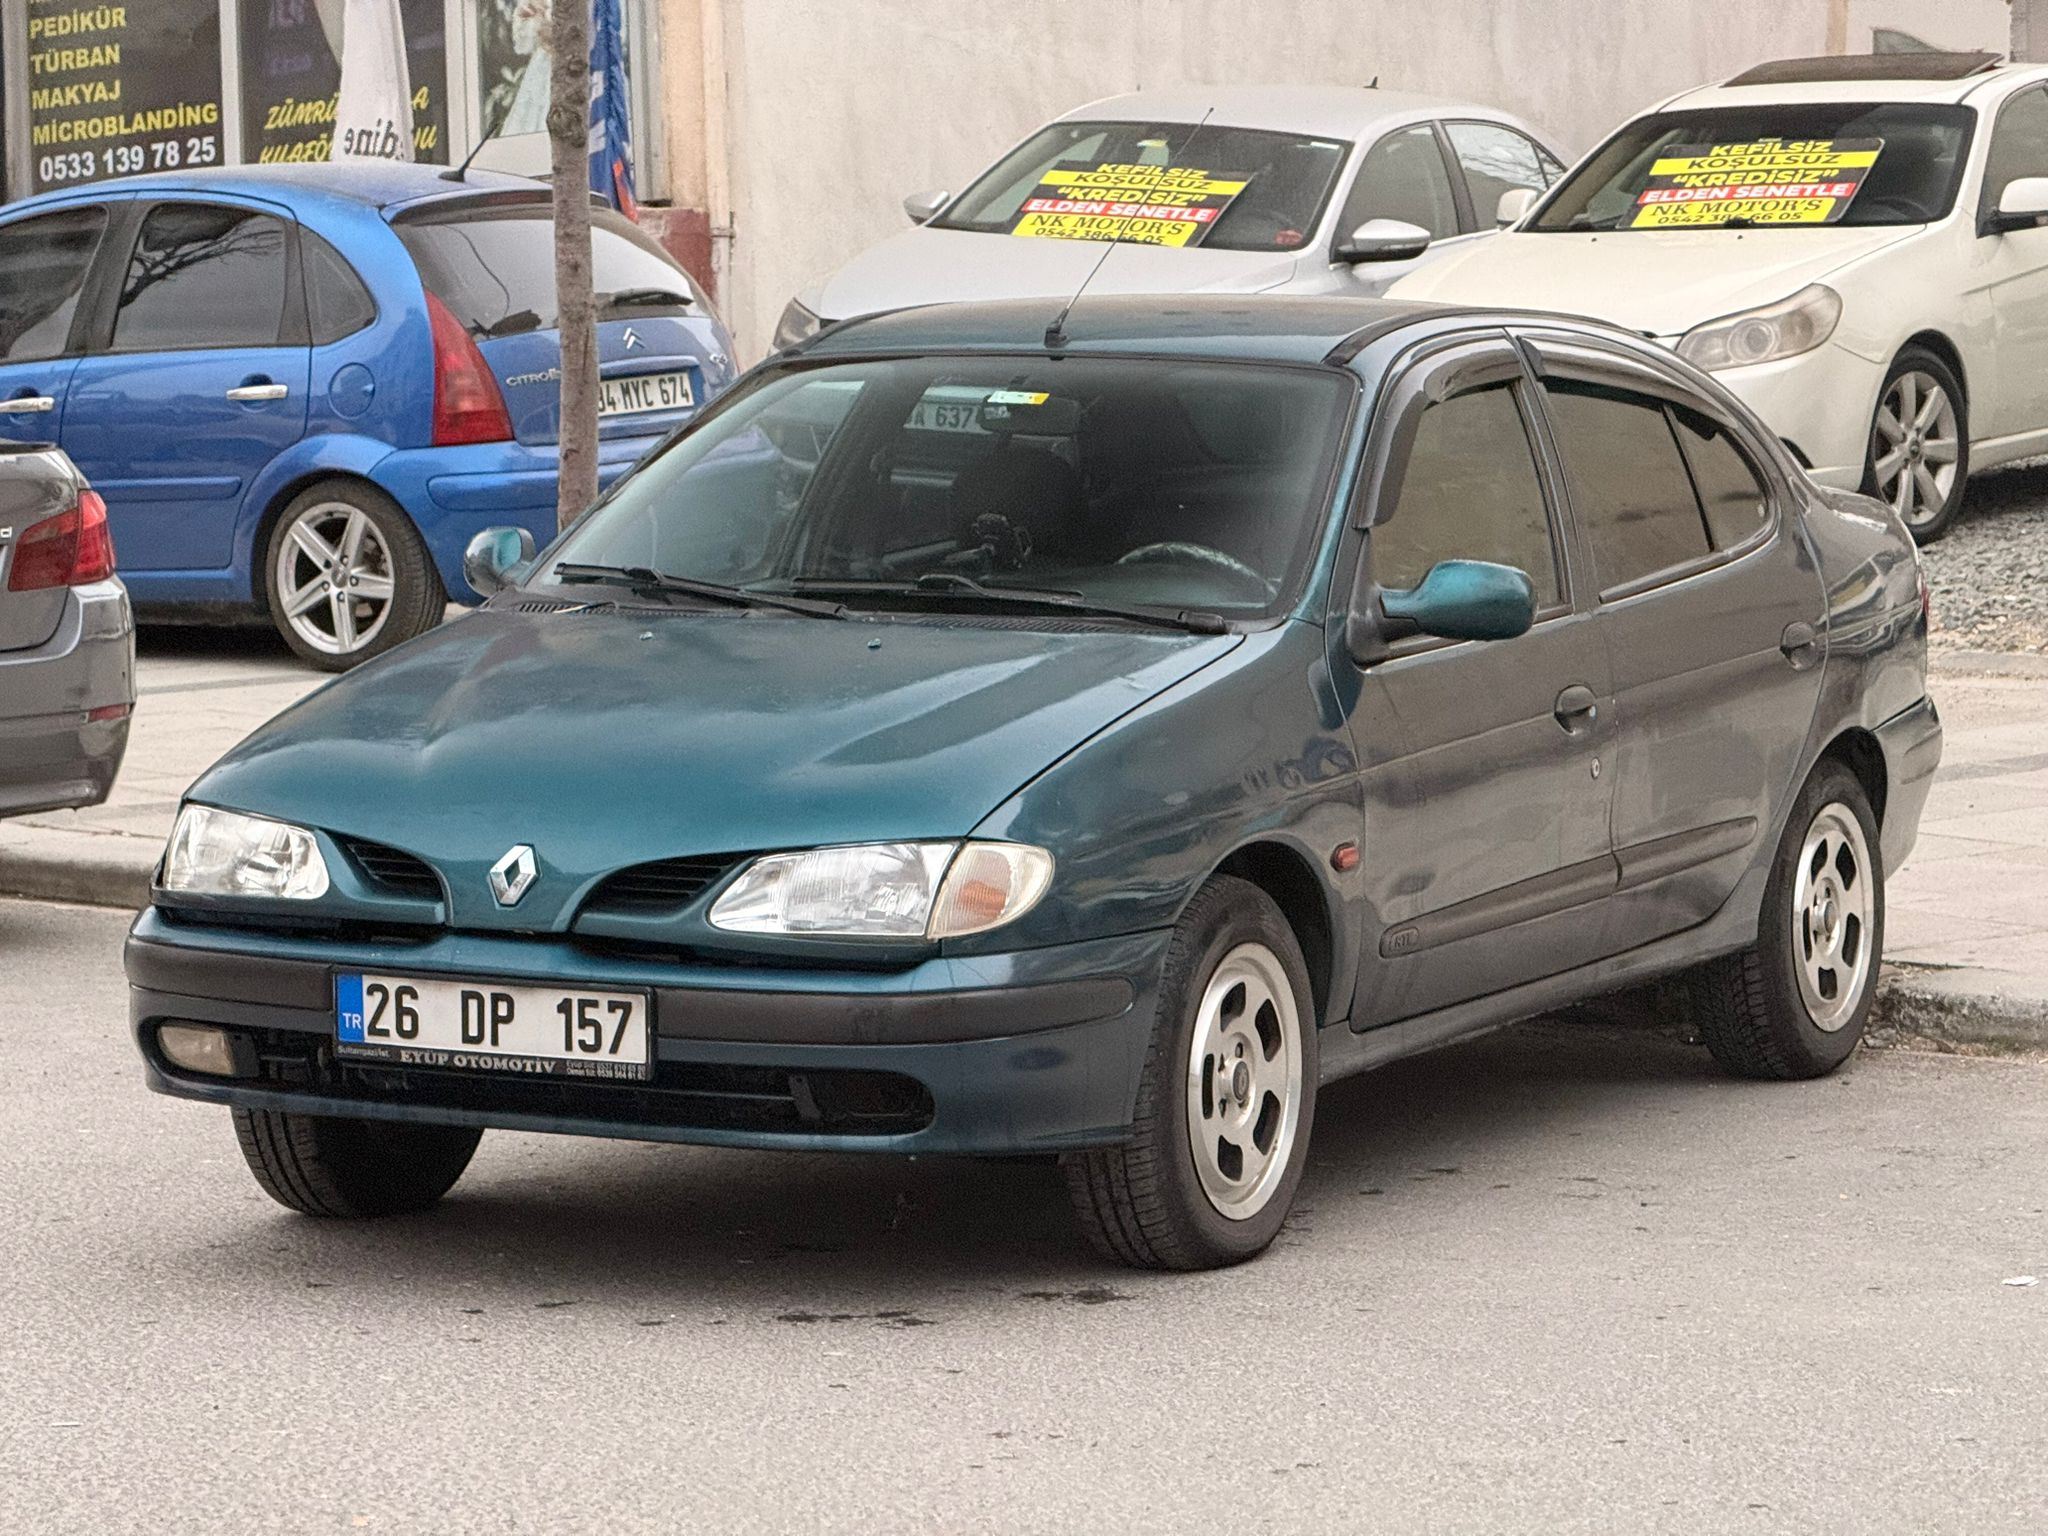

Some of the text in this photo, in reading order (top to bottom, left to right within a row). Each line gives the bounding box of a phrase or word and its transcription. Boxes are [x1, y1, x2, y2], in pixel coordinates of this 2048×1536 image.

[30, 5, 126, 39] PEDİKÜR
[30, 43, 121, 74] TÜRBAN
[31, 79, 121, 110] MAKYAJ
[33, 102, 218, 146] MİCROBLANDİNG
[39, 136, 216, 182] 0533 139 78 25
[1709, 140, 1834, 157] KEFİLSİZ
[1096, 163, 1210, 180] KEFİLSİZ
[1687, 154, 1842, 169] KOŞULSUZ
[1073, 173, 1213, 190] KOŞULSUZ
[1643, 183, 1848, 203] ELDEN SENETLE
[1027, 199, 1212, 222] ELDEN SENETLE
[1651, 199, 1823, 216] NK MOTOR'S
[1657, 215, 1704, 224] 0542
[1778, 211, 1803, 220] 05
[1029, 214, 1070, 228] NK
[620, 379, 654, 409] MYC
[658, 375, 690, 405] 674
[935, 406, 973, 428] 637
[342, 1012, 362, 1029] TR
[366, 983, 633, 1054] 26 DP 157
[400, 1049, 449, 1070] EYÜP
[453, 1054, 557, 1074] OTOMOTİV
